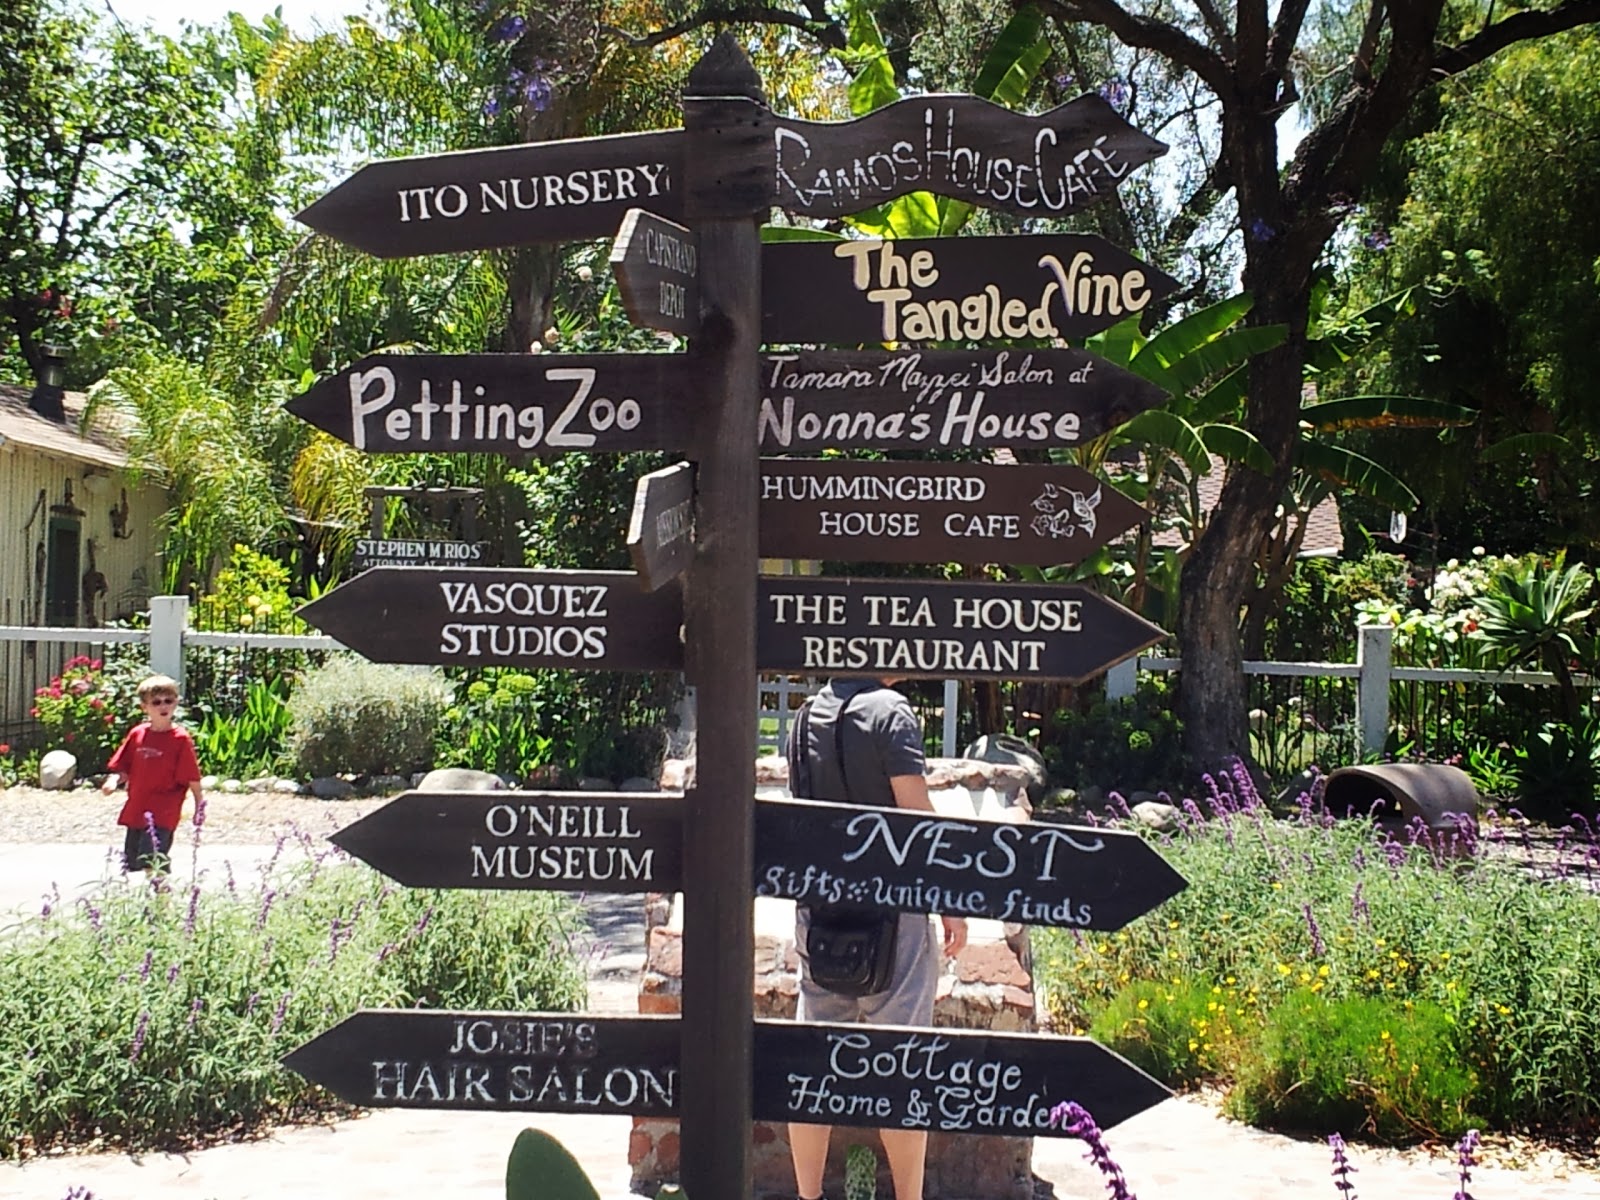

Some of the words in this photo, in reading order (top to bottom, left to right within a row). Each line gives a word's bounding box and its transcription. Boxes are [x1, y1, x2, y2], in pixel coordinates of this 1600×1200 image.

[398, 185, 469, 222] ITO
[480, 164, 663, 213] NURSERY
[834, 240, 939, 291] The
[867, 281, 1058, 341] Tangled
[1038, 251, 1151, 316] Vine
[767, 354, 875, 390] Tamara
[978, 350, 1054, 388] Salon
[1068, 361, 1094, 385] at
[350, 366, 545, 450] Petting
[545, 368, 642, 447] Zoo
[758, 396, 931, 447] Nonna's
[939, 391, 1081, 446] House
[761, 476, 986, 502] HUMMINGBIRD
[819, 512, 920, 537] HOUSE
[944, 513, 1020, 539] CAFE
[356, 540, 426, 557] STEPHEN
[429, 542, 441, 558] M
[444, 543, 481, 560] RIOS
[440, 583, 608, 618] VASQUEZ
[769, 594, 847, 625] THE
[862, 596, 937, 627] TEA
[952, 598, 1084, 632] HOUSE
[440, 624, 608, 659] STUDIOS
[802, 636, 1046, 672] RESTAURANT
[485, 805, 643, 839] O'NEILL
[470, 845, 655, 881] MUSEUM
[842, 812, 1106, 882] NEST
[998, 888, 1093, 926] finds
[372, 1061, 497, 1102] HAIR
[508, 1064, 679, 1108] SALON
[826, 1034, 1023, 1103] Cottage
[786, 1073, 893, 1118] Home
[900, 1089, 933, 1128] &
